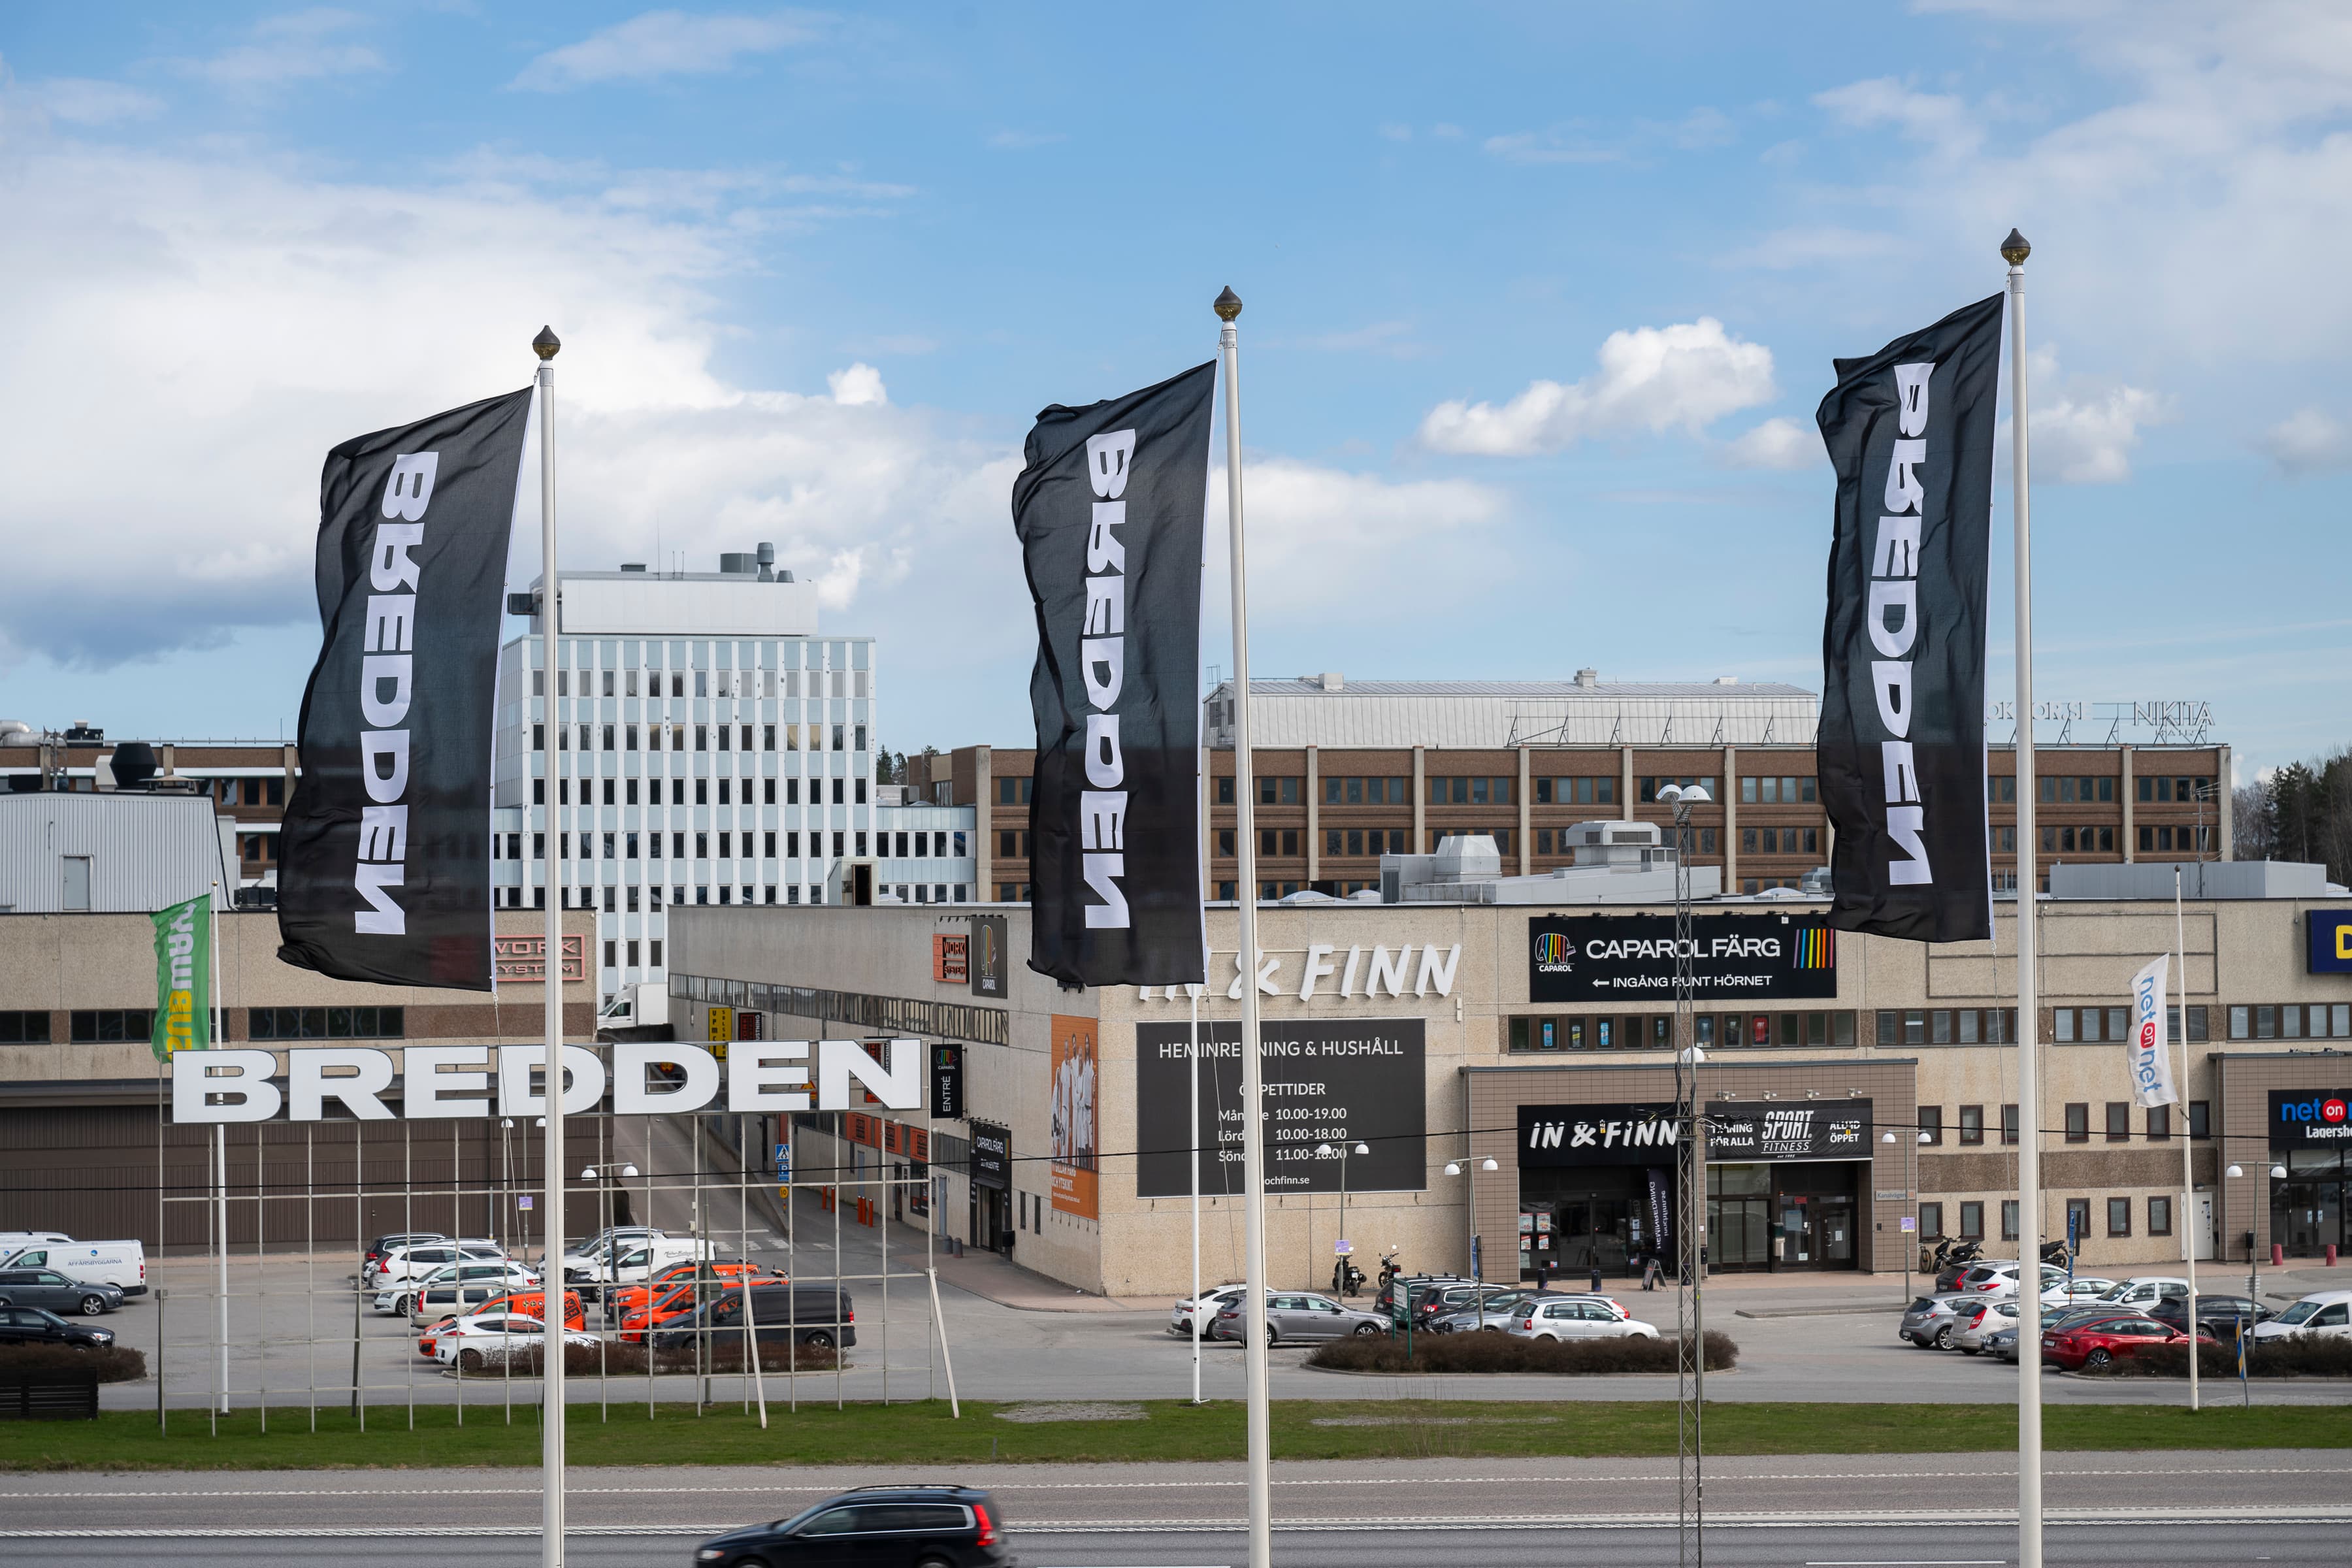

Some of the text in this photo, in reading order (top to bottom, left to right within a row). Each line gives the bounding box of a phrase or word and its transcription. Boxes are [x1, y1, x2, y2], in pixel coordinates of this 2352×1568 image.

[2134, 701, 2215, 726] NIKITA
[943, 941, 965, 956] WORK
[1586, 934, 1780, 959] CAPAROL FÄRG
[496, 964, 575, 973] YSTM
[944, 966, 966, 975] SYSTEM
[1299, 943, 1461, 1002] FINN
[982, 978, 996, 990] CAPAROL
[1613, 973, 1773, 988] INGÅNG RUNT HÖRNET
[1159, 1036, 1403, 1059] HEMINRENING & HUSHÅLL
[172, 1039, 922, 1123] BREDDEN
[941, 1075, 951, 1112] ENTRÉ
[1239, 1081, 1326, 1096] PETTIDER
[1218, 1108, 1347, 1121] Måne 10.00-19.00
[1218, 1128, 1347, 1141] Lörd 10.00-18.00
[1530, 1120, 1679, 1149] IN & FINN
[1710, 1123, 1753, 1134] TNING
[1730, 1137, 1755, 1146] ALLA
[1830, 1132, 1860, 1143] ÖPPET
[977, 1136, 1004, 1154] CAPAROL FÄRG
[1763, 1141, 1810, 1152] FITNESS
[1264, 1176, 1310, 1185] ochfinn.se
[67, 1258, 123, 1267] AFFÄRSBYGGARNA
